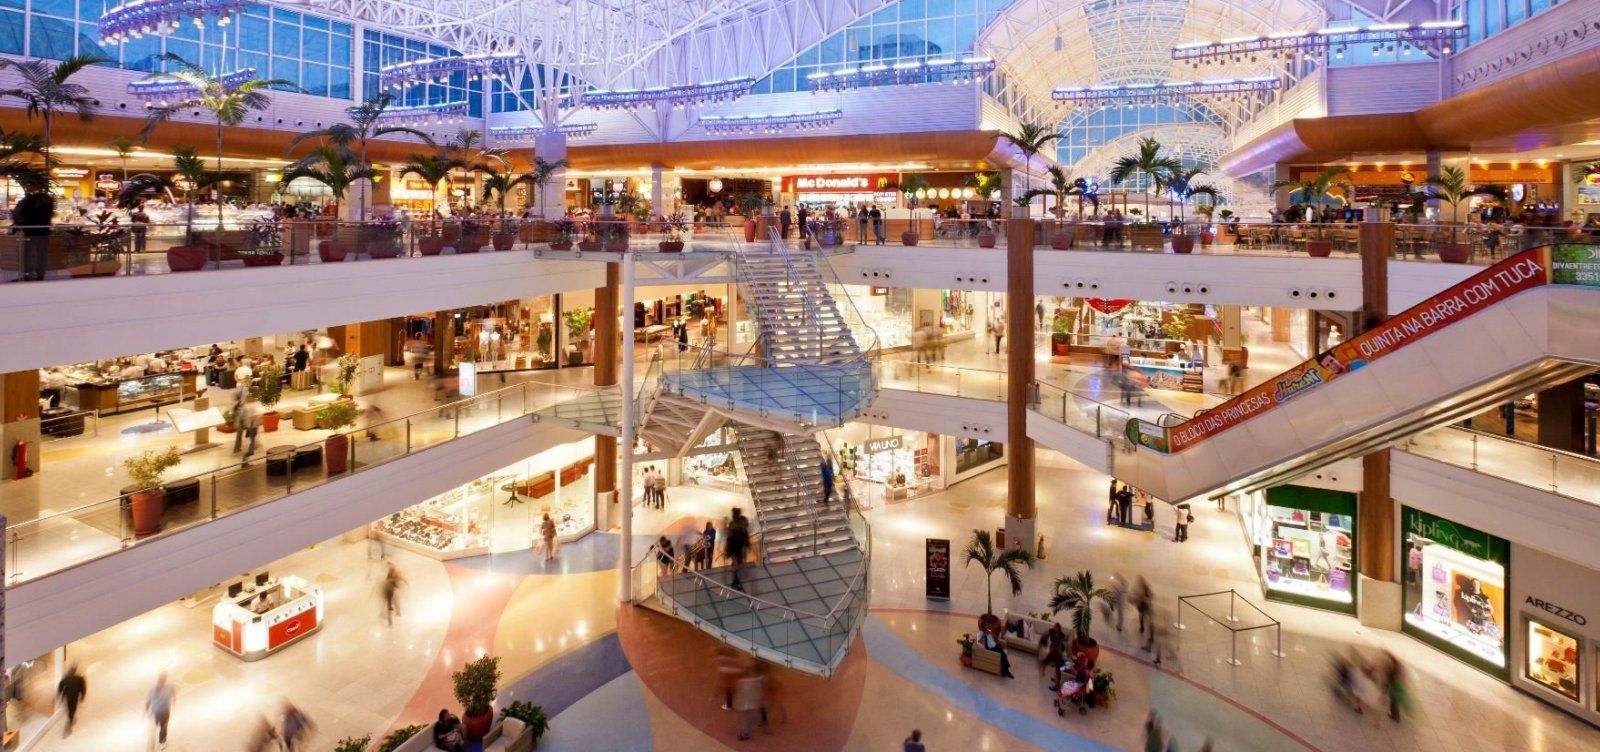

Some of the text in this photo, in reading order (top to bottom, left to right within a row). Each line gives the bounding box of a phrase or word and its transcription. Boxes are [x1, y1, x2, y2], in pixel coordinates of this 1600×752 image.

[796, 177, 869, 188] McDonald's
[1360, 258, 1544, 357] QUINTA NA BARRA COM TUCA
[1173, 434, 1181, 446] O
[1179, 422, 1206, 443] BLOCO
[1204, 414, 1223, 431] DAS
[1221, 392, 1271, 423] PRINCESAS
[869, 438, 899, 451] VIA UNO
[1410, 513, 1459, 549] kipling
[1525, 595, 1587, 626] AREZZO
